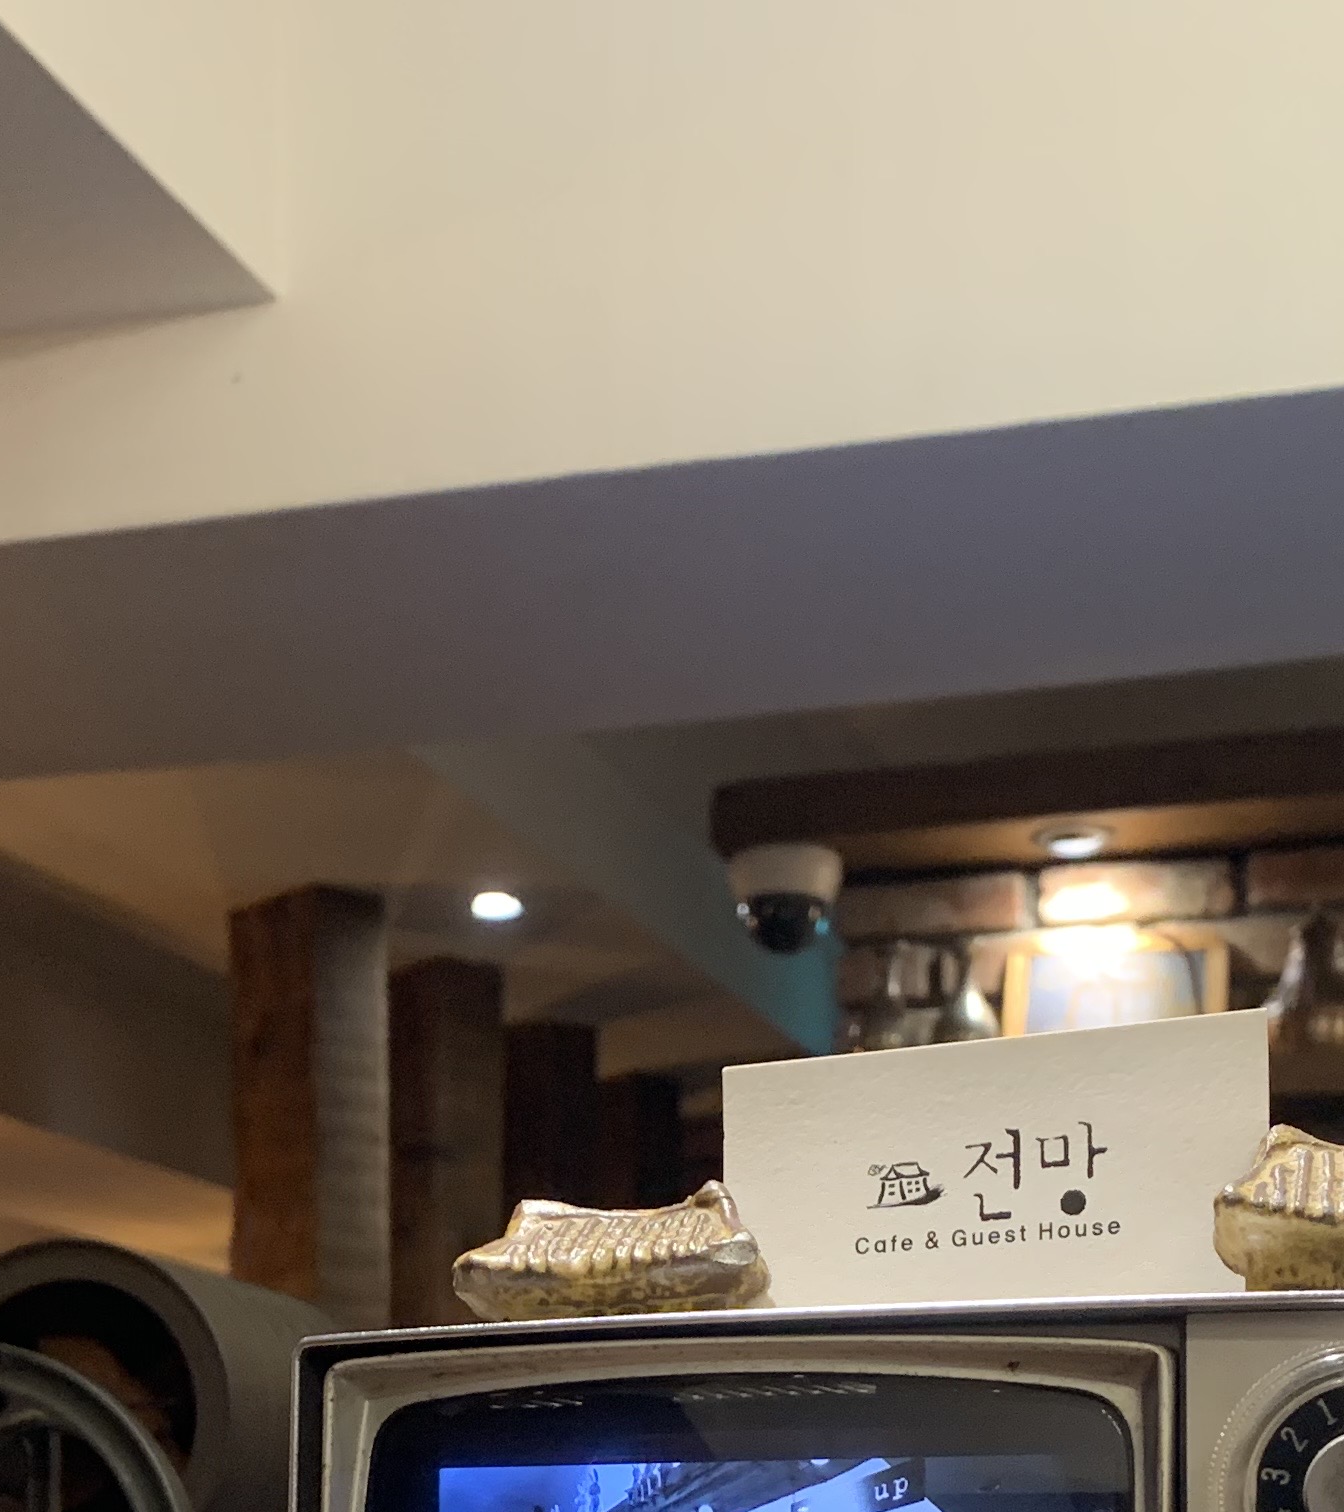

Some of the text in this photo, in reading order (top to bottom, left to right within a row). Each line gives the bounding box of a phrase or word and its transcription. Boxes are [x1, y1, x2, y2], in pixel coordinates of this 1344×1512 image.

[854, 1217, 1121, 1256] Cafe & Guest House
[1317, 1398, 1338, 1427] 1
[1280, 1426, 1309, 1453] 2
[874, 1476, 909, 1501] up
[1260, 1466, 1291, 1485] 3
